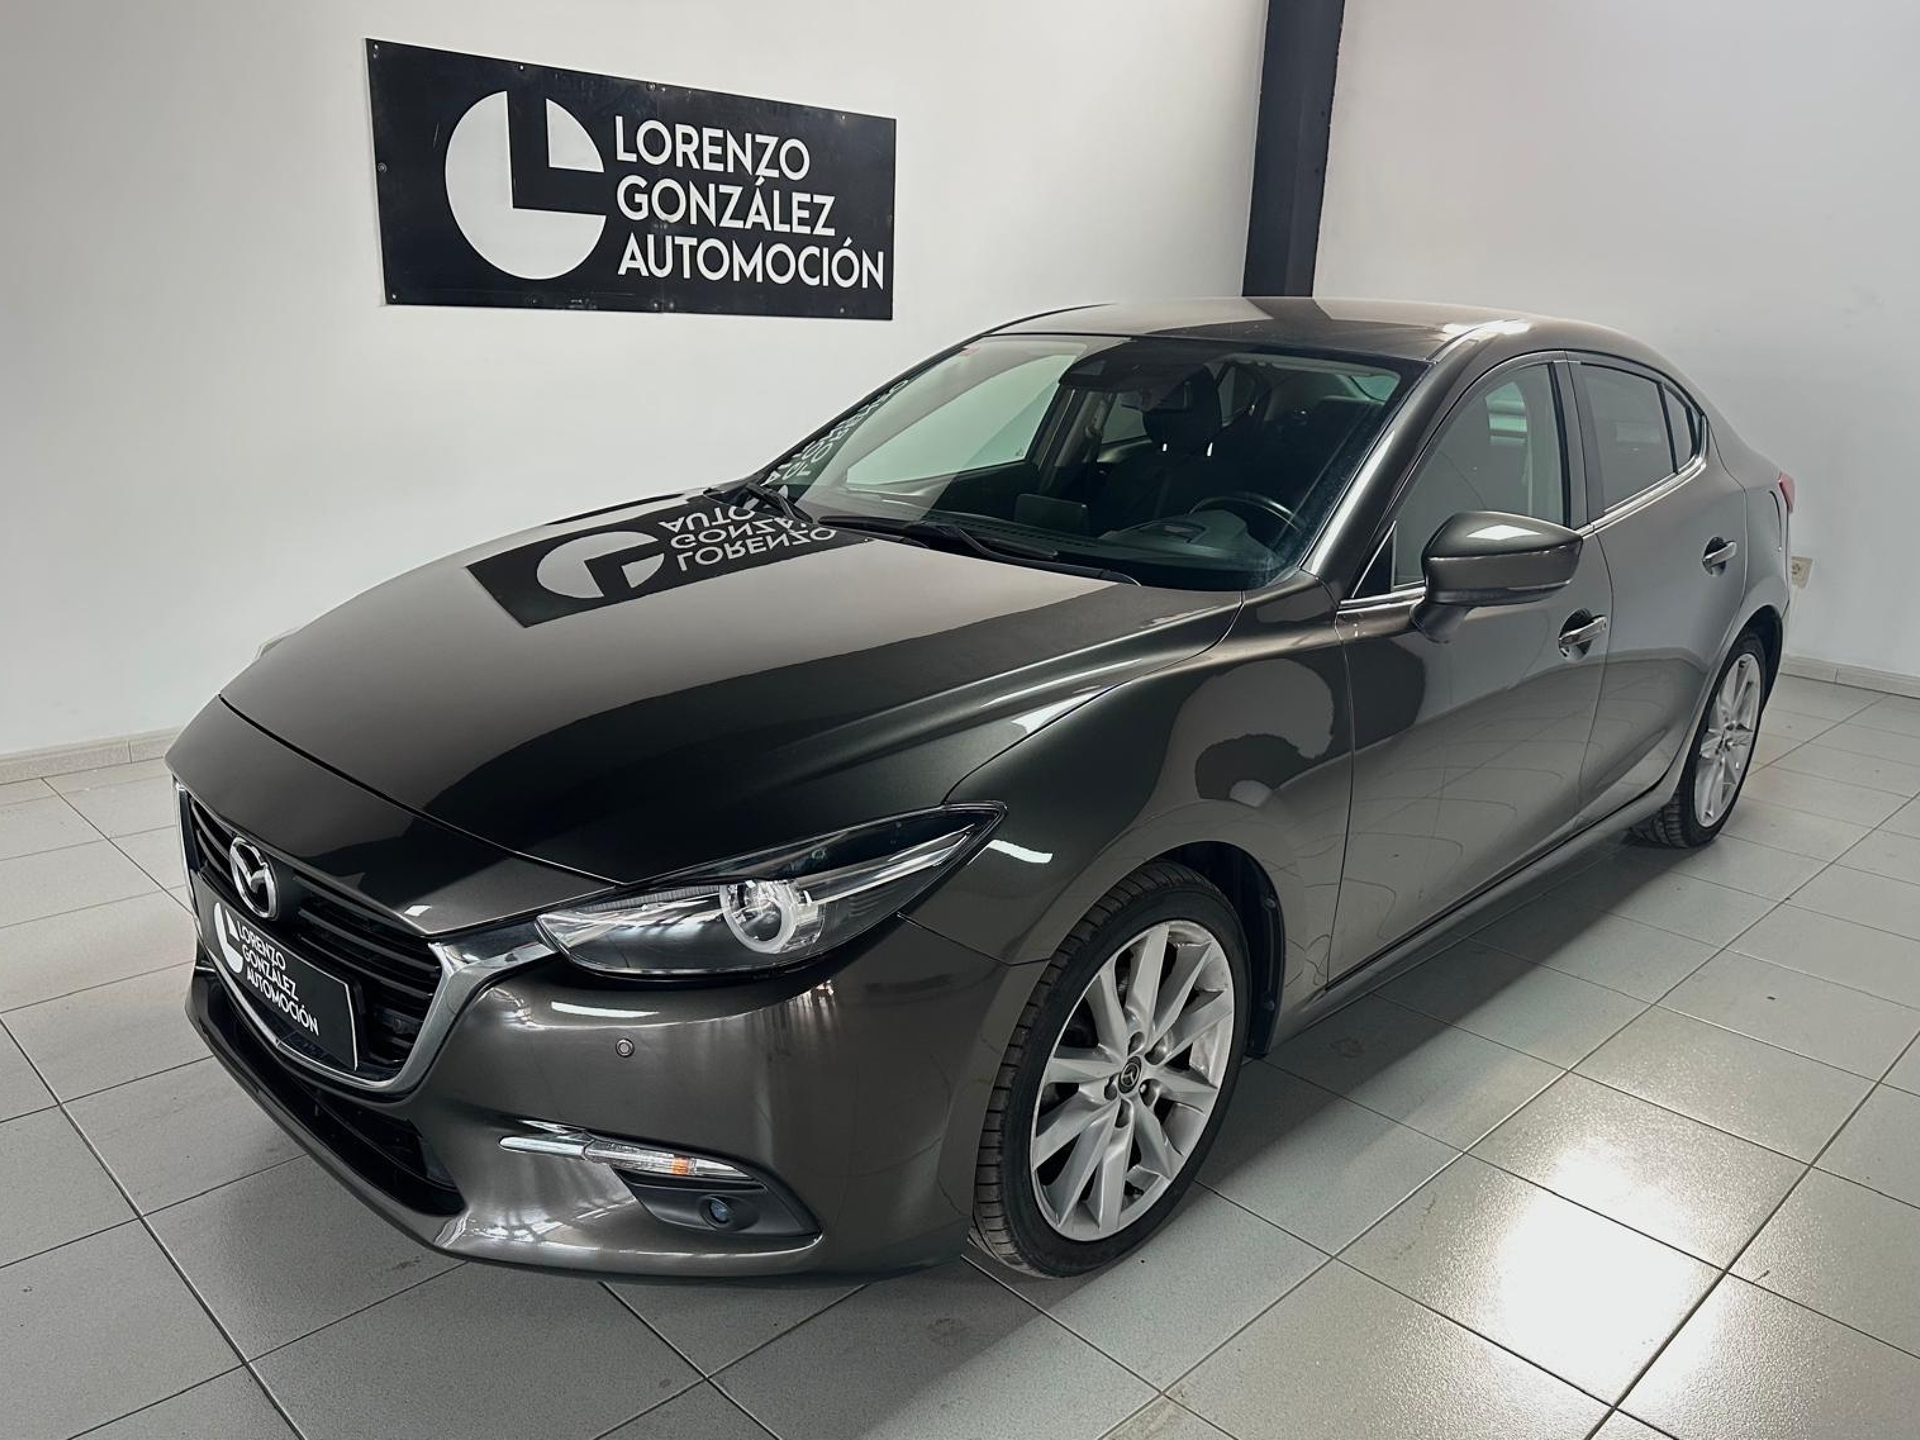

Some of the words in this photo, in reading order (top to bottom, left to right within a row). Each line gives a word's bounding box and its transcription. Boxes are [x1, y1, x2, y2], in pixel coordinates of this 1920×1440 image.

[615, 116, 810, 180] LORENZO
[617, 175, 835, 236] GONZÁLEZ
[618, 233, 884, 289] AUTOMOCIÓN
[238, 921, 286, 970] LORENZO
[241, 943, 299, 1002] GONZÁLEZ
[246, 966, 320, 1037] AUTOMOCIÓN
